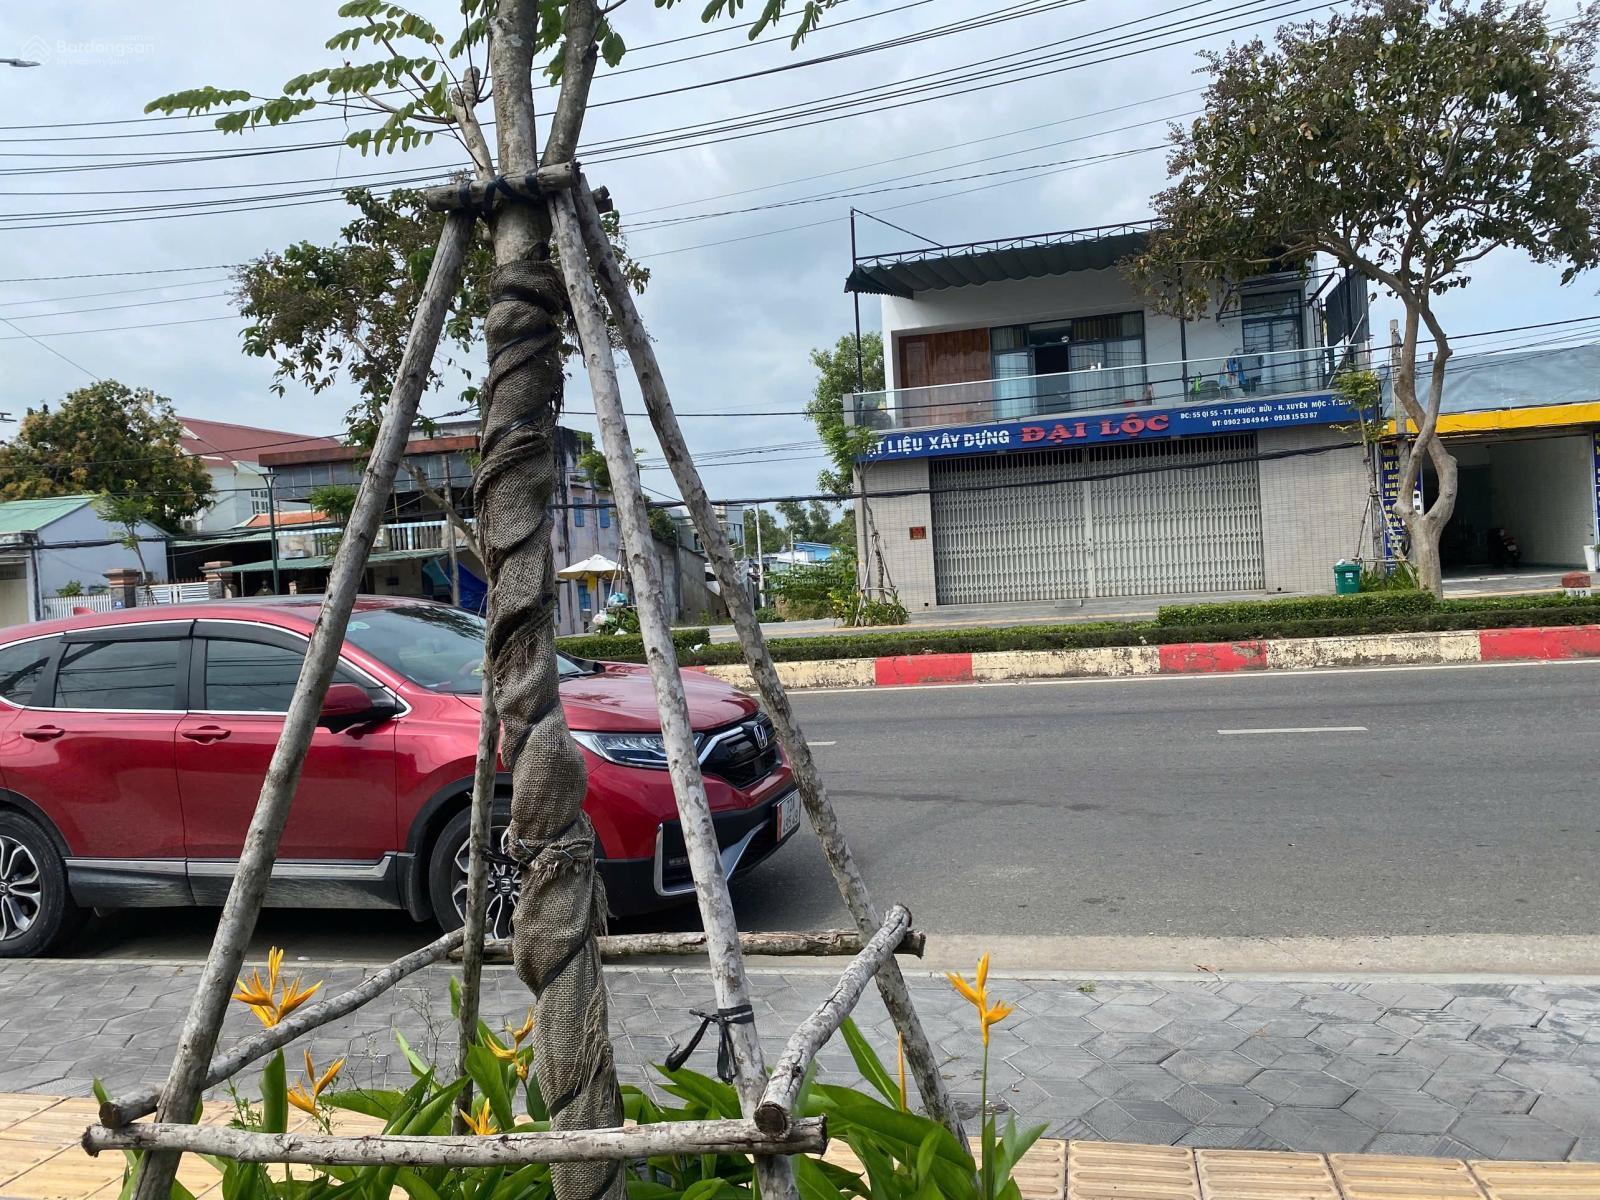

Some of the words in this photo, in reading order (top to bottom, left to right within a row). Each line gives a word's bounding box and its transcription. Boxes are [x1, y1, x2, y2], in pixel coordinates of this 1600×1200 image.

[887, 436, 923, 455] LIỆU
[929, 433, 960, 450] XÂY
[964, 430, 1010, 449] DỰNG
[1021, 422, 1088, 444] ĐẠI
[1100, 412, 1169, 437] LỘC
